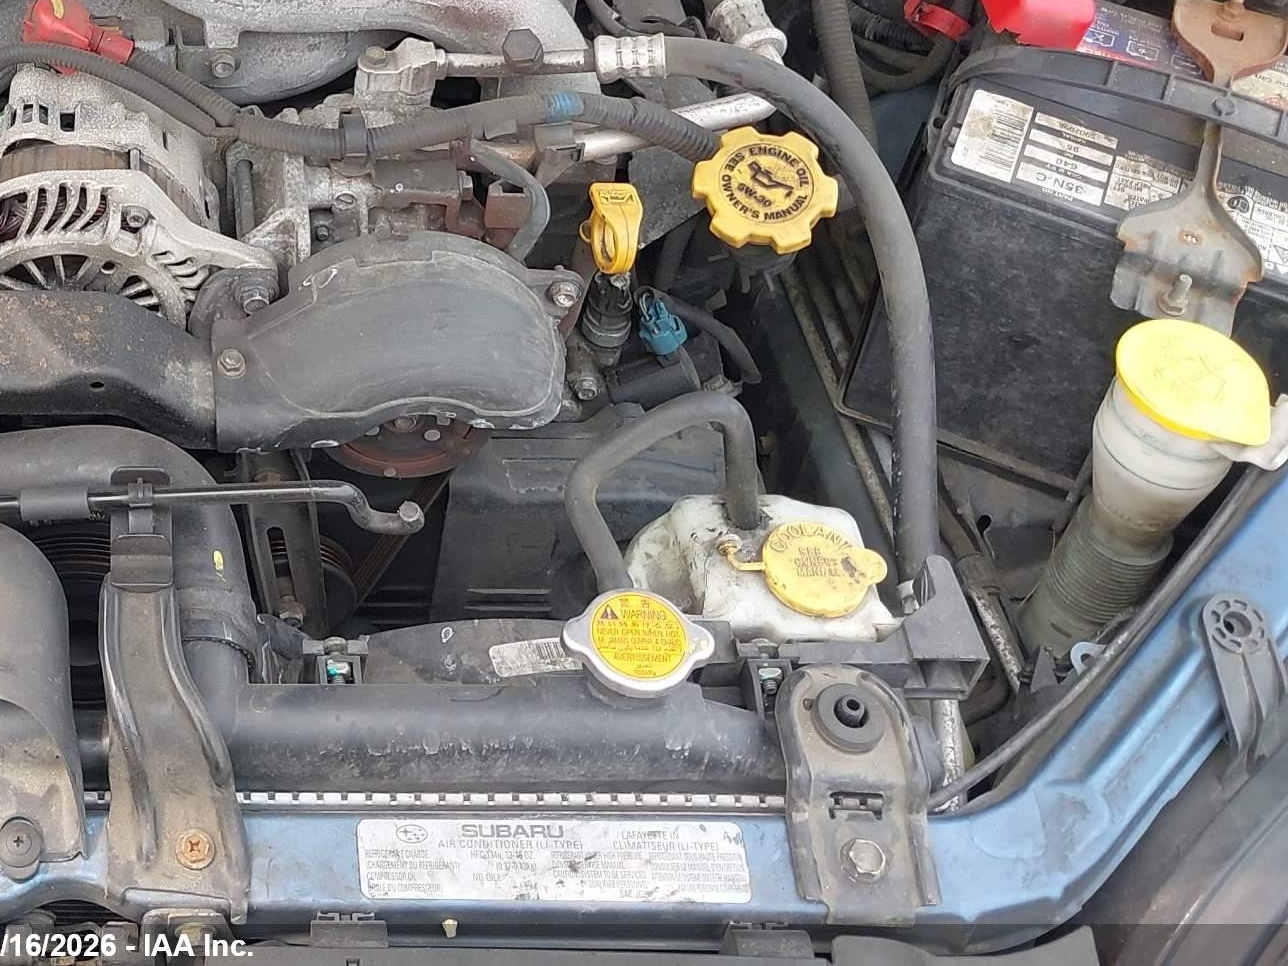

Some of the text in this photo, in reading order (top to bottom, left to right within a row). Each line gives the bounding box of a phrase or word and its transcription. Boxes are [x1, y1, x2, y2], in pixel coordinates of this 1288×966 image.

[748, 146, 811, 187] ENGINE OIL
[1055, 158, 1078, 170] 640
[721, 151, 808, 221] SEE OWNER'S MANUAL
[1034, 171, 1085, 194] 35N-C
[769, 522, 853, 553] COOLANT
[620, 609, 667, 621] WARNING
[596, 628, 619, 636] NEVER
[622, 630, 643, 638] OPEN
[645, 630, 665, 639] WHEN
[613, 653, 673, 663] AVERTISSEMENT
[461, 824, 564, 839] SUBARU
[621, 829, 679, 840] LAFAYETTE IN
[438, 839, 583, 850] AIR CONDITIONER (LI-TYPE)
[613, 841, 675, 851] CLIMATISEUR
